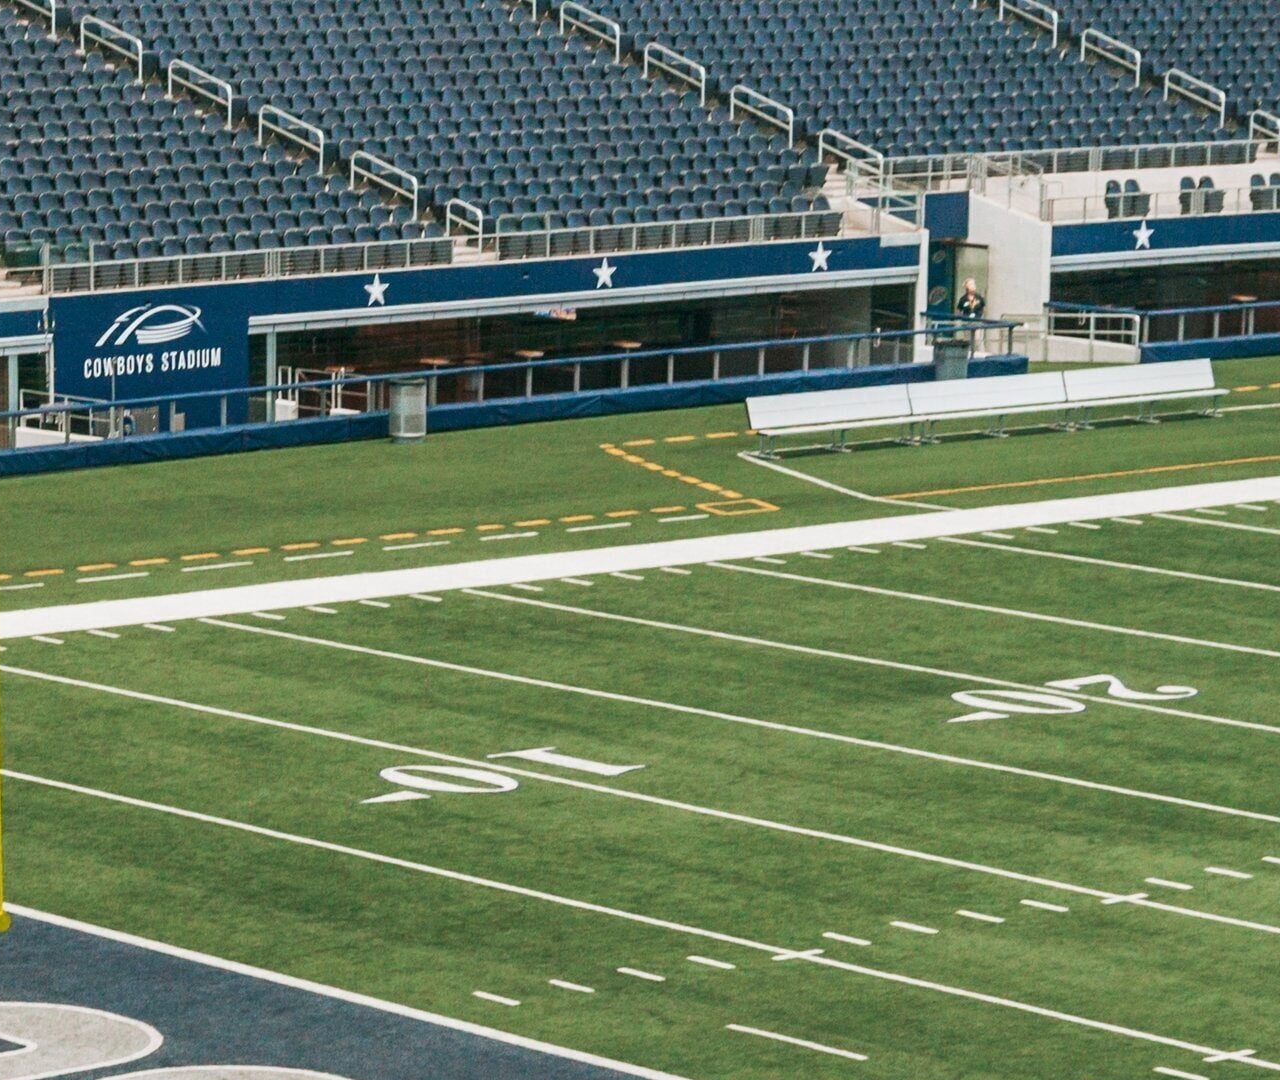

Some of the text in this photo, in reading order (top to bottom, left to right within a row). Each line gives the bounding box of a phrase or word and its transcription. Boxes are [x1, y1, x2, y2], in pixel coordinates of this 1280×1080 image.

[83, 347, 222, 379] COWBOYS STADIUM
[951, 674, 1199, 714] 20
[379, 746, 646, 793] 10
